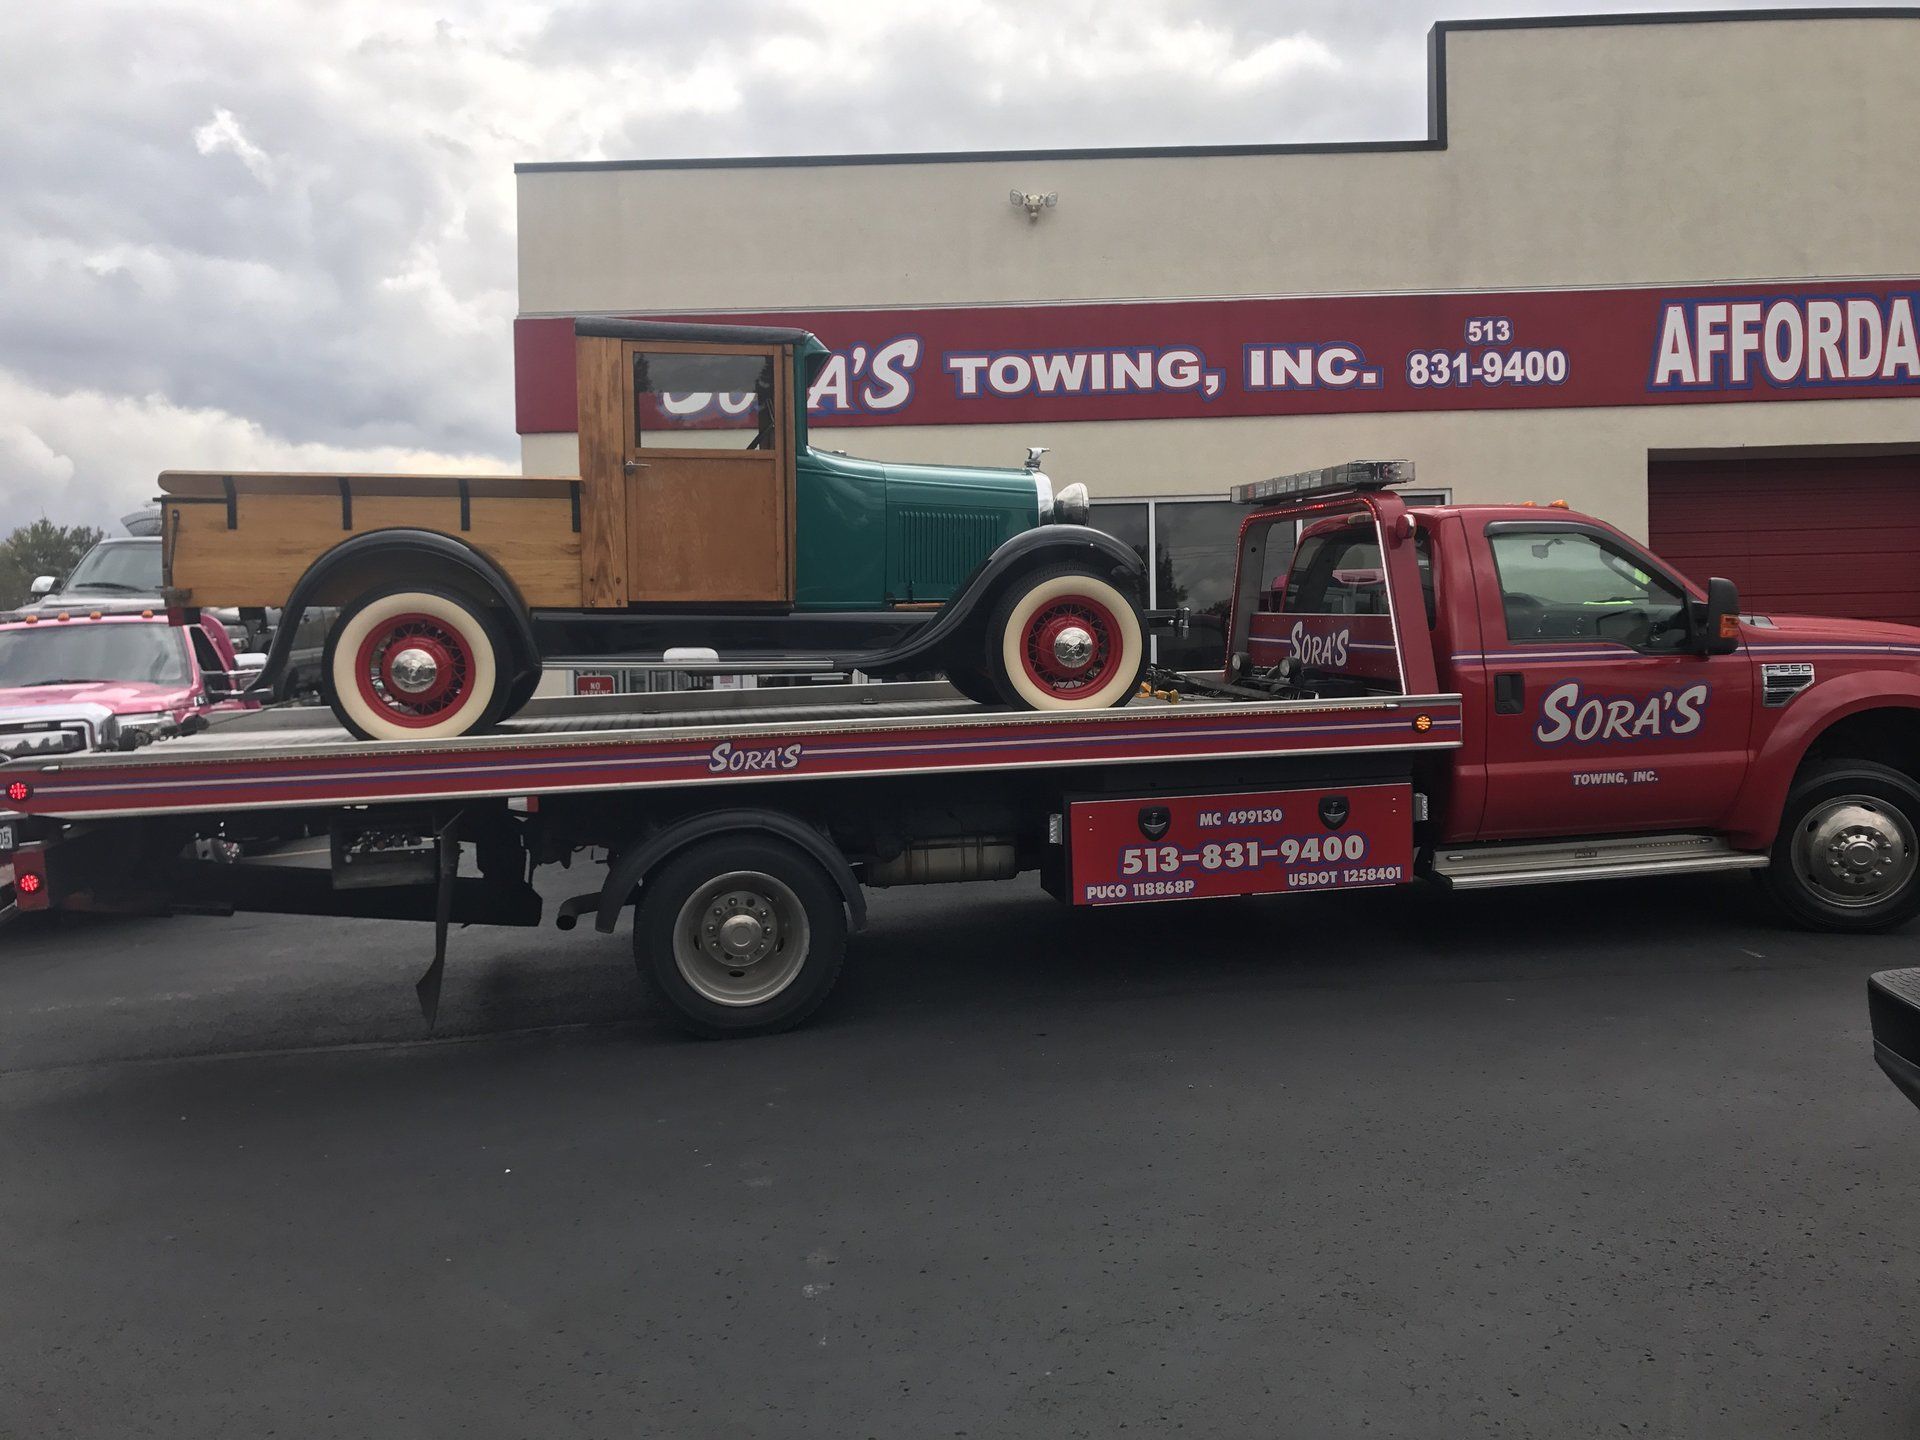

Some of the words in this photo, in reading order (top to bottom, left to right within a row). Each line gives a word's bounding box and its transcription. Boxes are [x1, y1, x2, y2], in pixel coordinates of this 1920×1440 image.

[1468, 320, 1511, 342] 513
[1655, 298, 1920, 384] AFFORDA
[663, 338, 919, 413] A'S
[949, 351, 1220, 395] TOWING,
[1250, 348, 1377, 386] INC.
[1409, 349, 1566, 386] 831-9400
[1290, 621, 1349, 666] SORA'S
[1766, 664, 1812, 672] F-550
[590, 682, 601, 690] NO
[1537, 683, 1707, 743] SORA'S
[709, 743, 801, 772] SORA'S
[1573, 772, 1628, 786] TOWING,
[1633, 771, 1659, 782] INC.
[1200, 812, 1222, 826] MC
[1228, 808, 1283, 824] 499130
[1123, 835, 1364, 875] 513-831-9400
[1288, 871, 1337, 886] USDOT
[1344, 866, 1401, 882] 1258401
[1087, 884, 1127, 899] PUCO
[1133, 880, 1195, 896] 118868P
